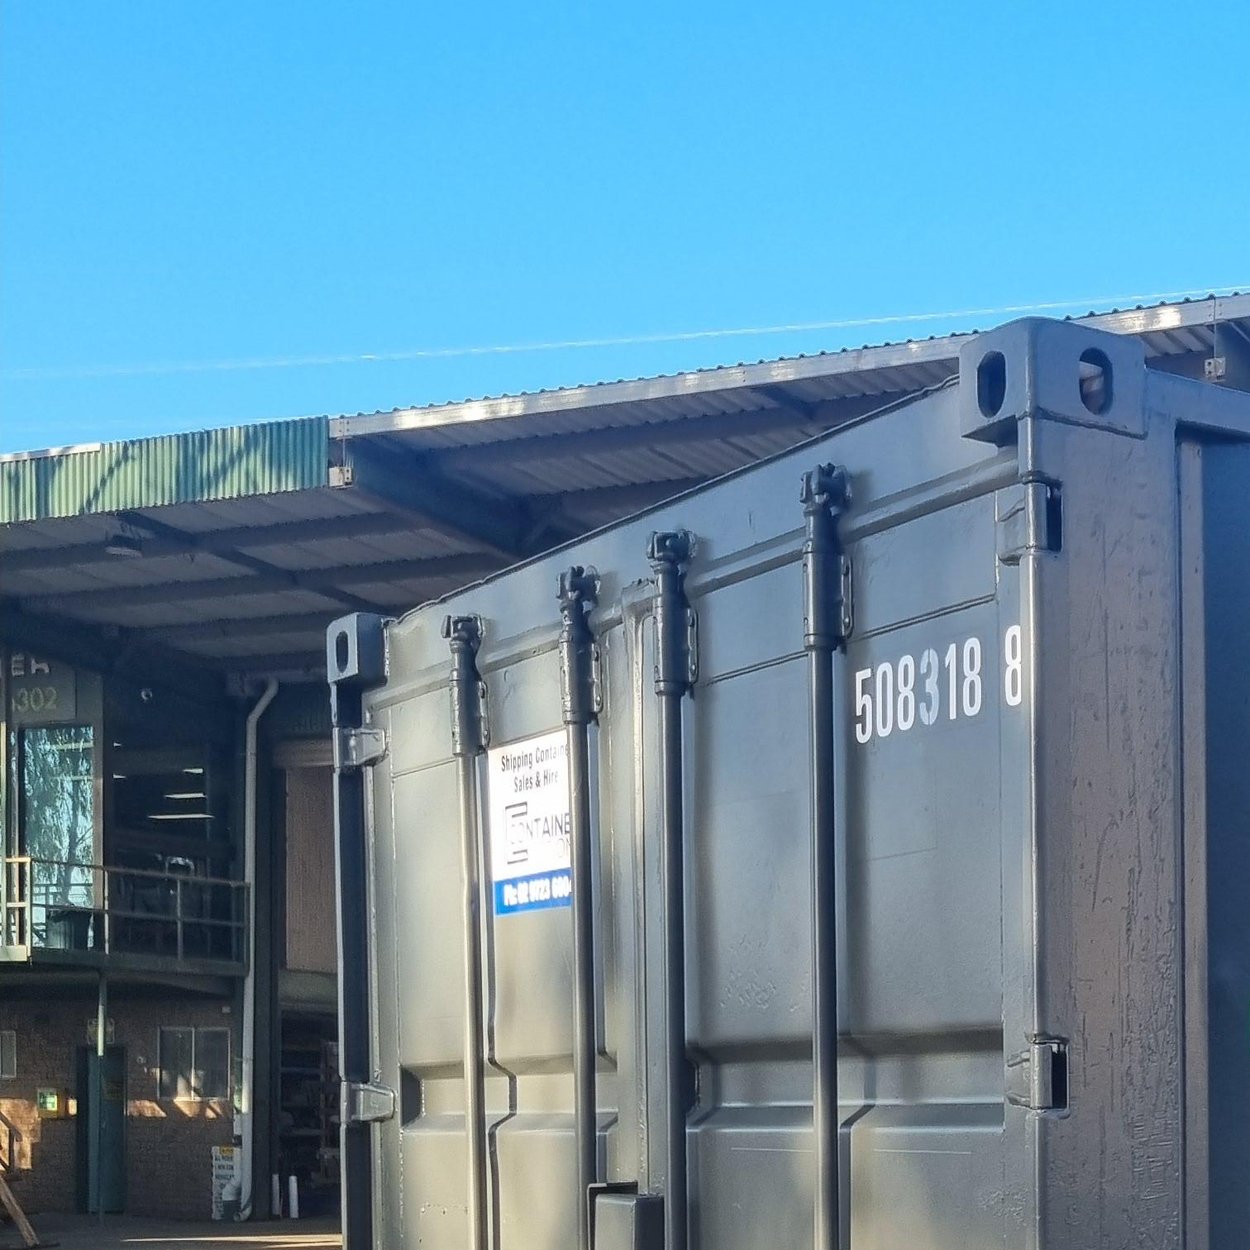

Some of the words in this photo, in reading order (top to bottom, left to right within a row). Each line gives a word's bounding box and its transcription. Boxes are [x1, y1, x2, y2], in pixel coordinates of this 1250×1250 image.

[855, 637, 982, 744] 508318
[1004, 625, 1022, 706] 8
[501, 752, 533, 773] Shipping
[535, 744, 569, 764] Containe
[514, 774, 533, 793] Sales
[535, 771, 541, 788] &
[543, 769, 559, 786] Hire
